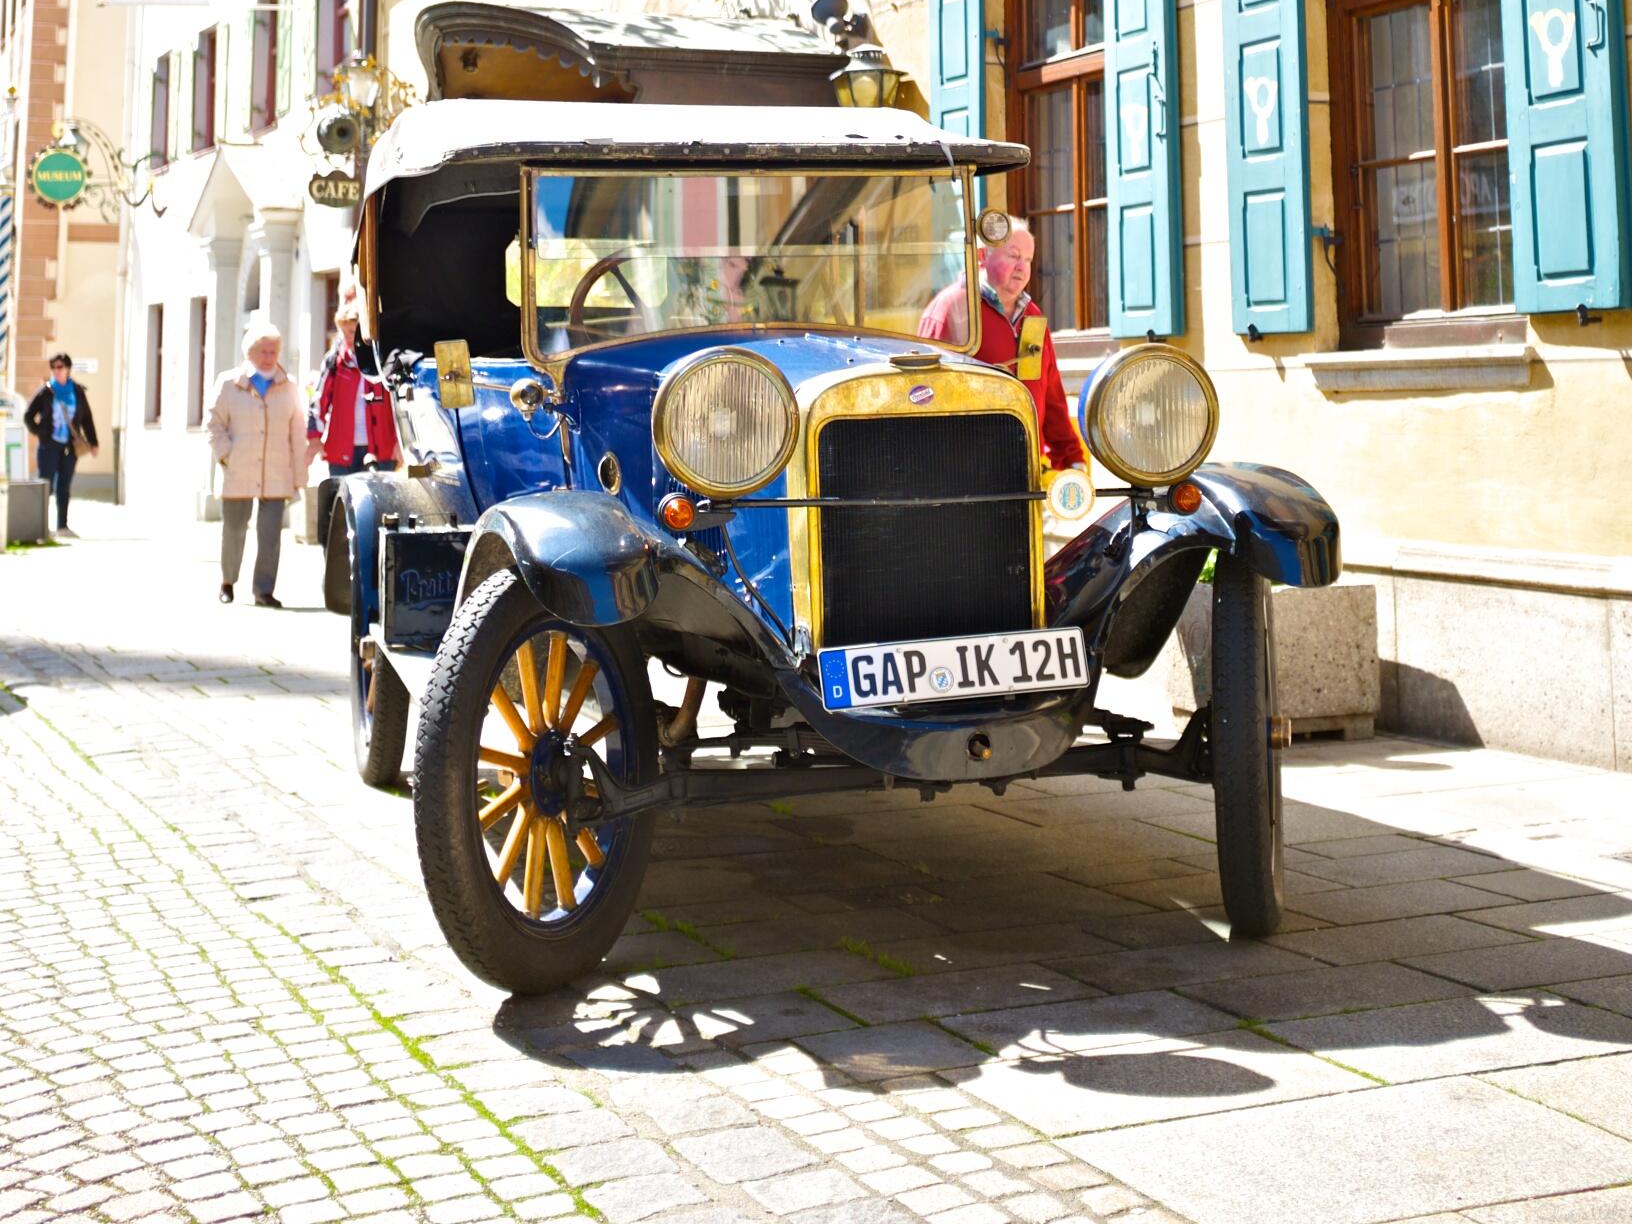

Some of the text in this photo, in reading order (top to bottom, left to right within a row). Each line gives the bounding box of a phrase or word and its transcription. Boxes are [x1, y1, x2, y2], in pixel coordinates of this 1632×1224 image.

[37, 170, 82, 182] MUSEUM
[851, 636, 1082, 699] GAP IK 12H
[833, 685, 843, 699] D
